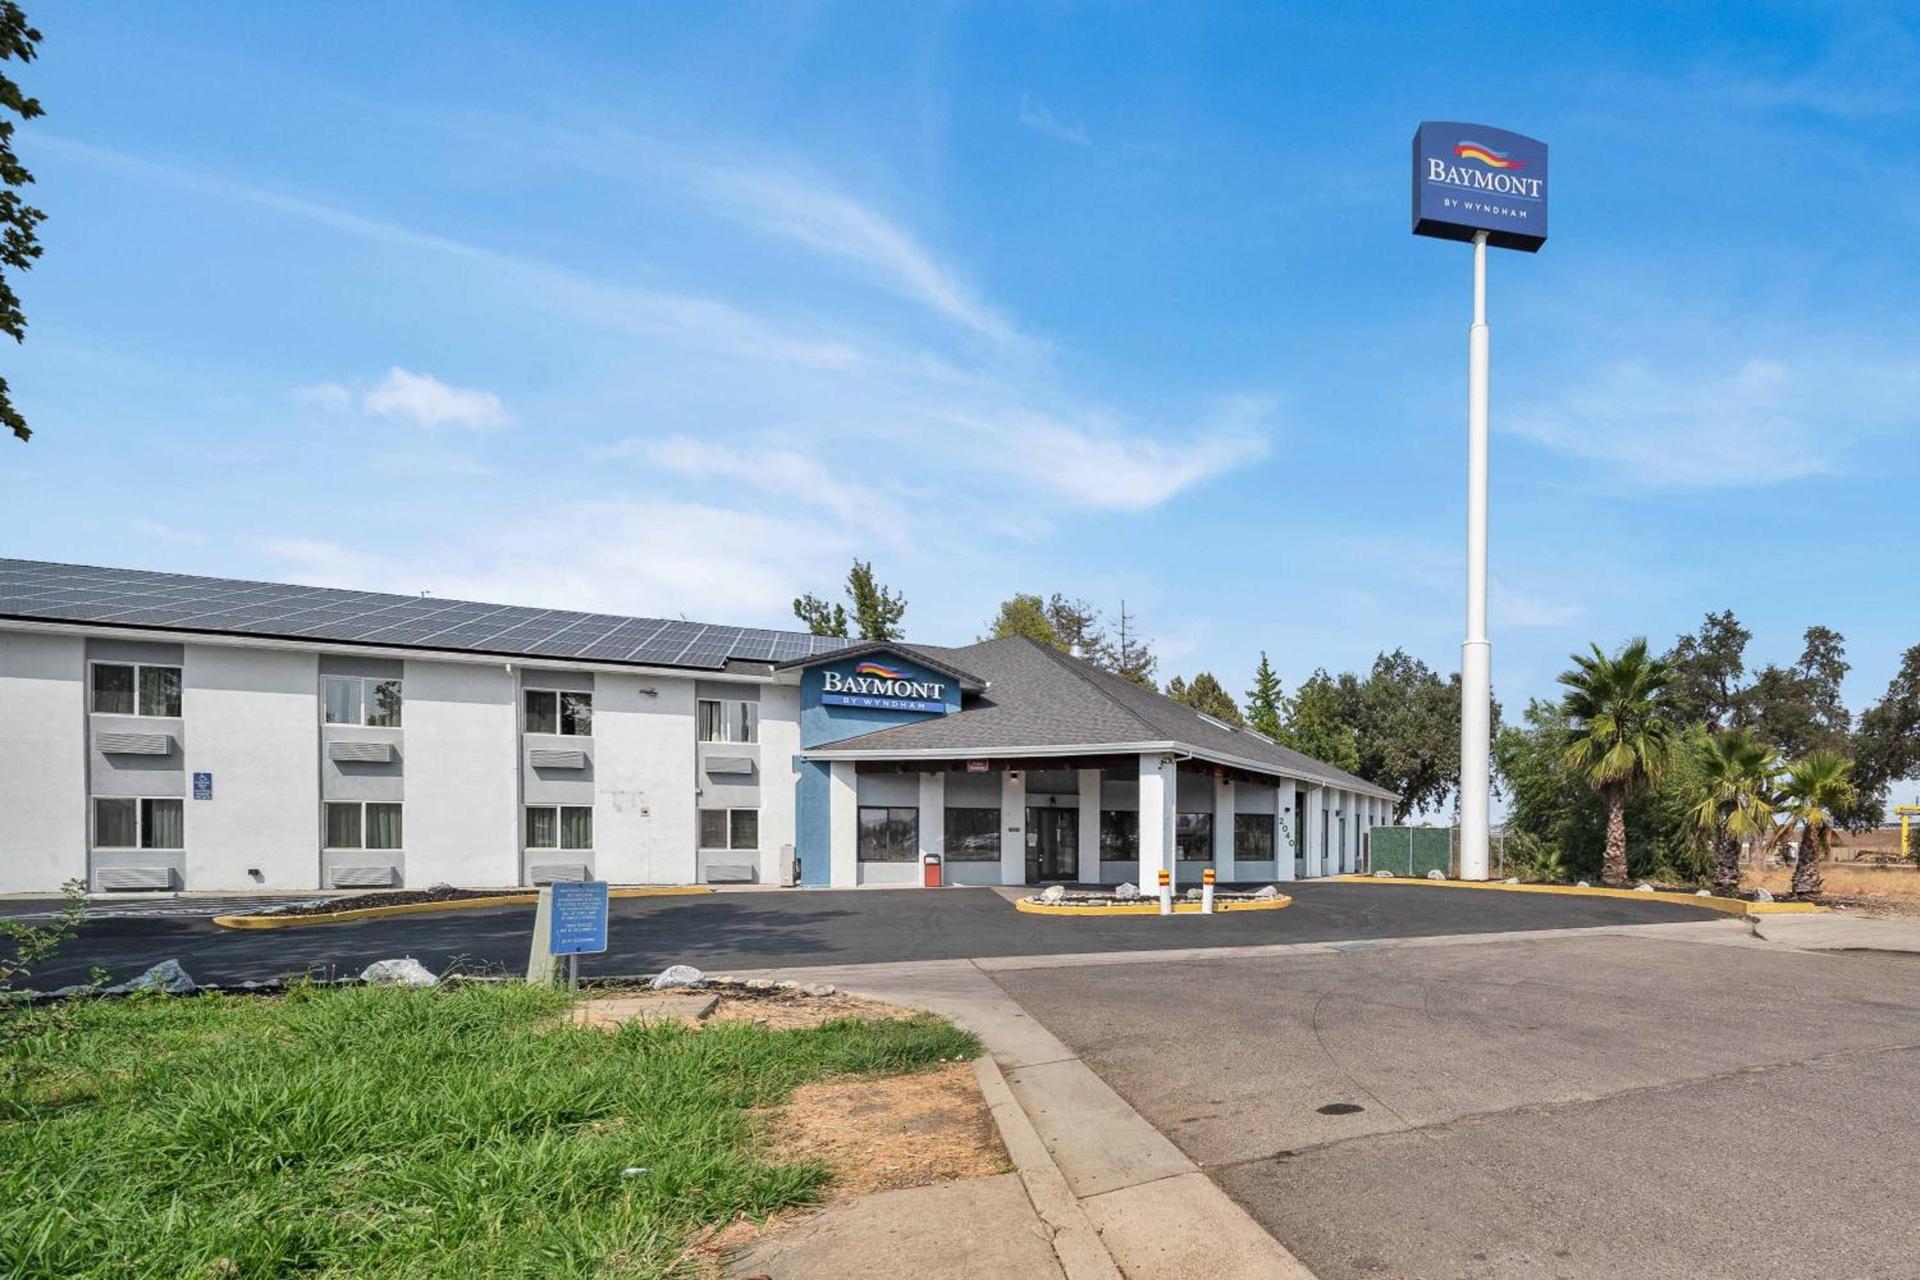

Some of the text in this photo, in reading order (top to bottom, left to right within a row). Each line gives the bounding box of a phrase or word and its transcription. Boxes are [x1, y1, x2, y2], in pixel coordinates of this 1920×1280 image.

[1428, 158, 1542, 197] BAYMONT
[1444, 198, 1527, 219] BY WYNDHAM
[822, 670, 944, 699] BAYMONT
[843, 696, 926, 709] BY WYNDHAM
[1279, 817, 1295, 847] 2040
